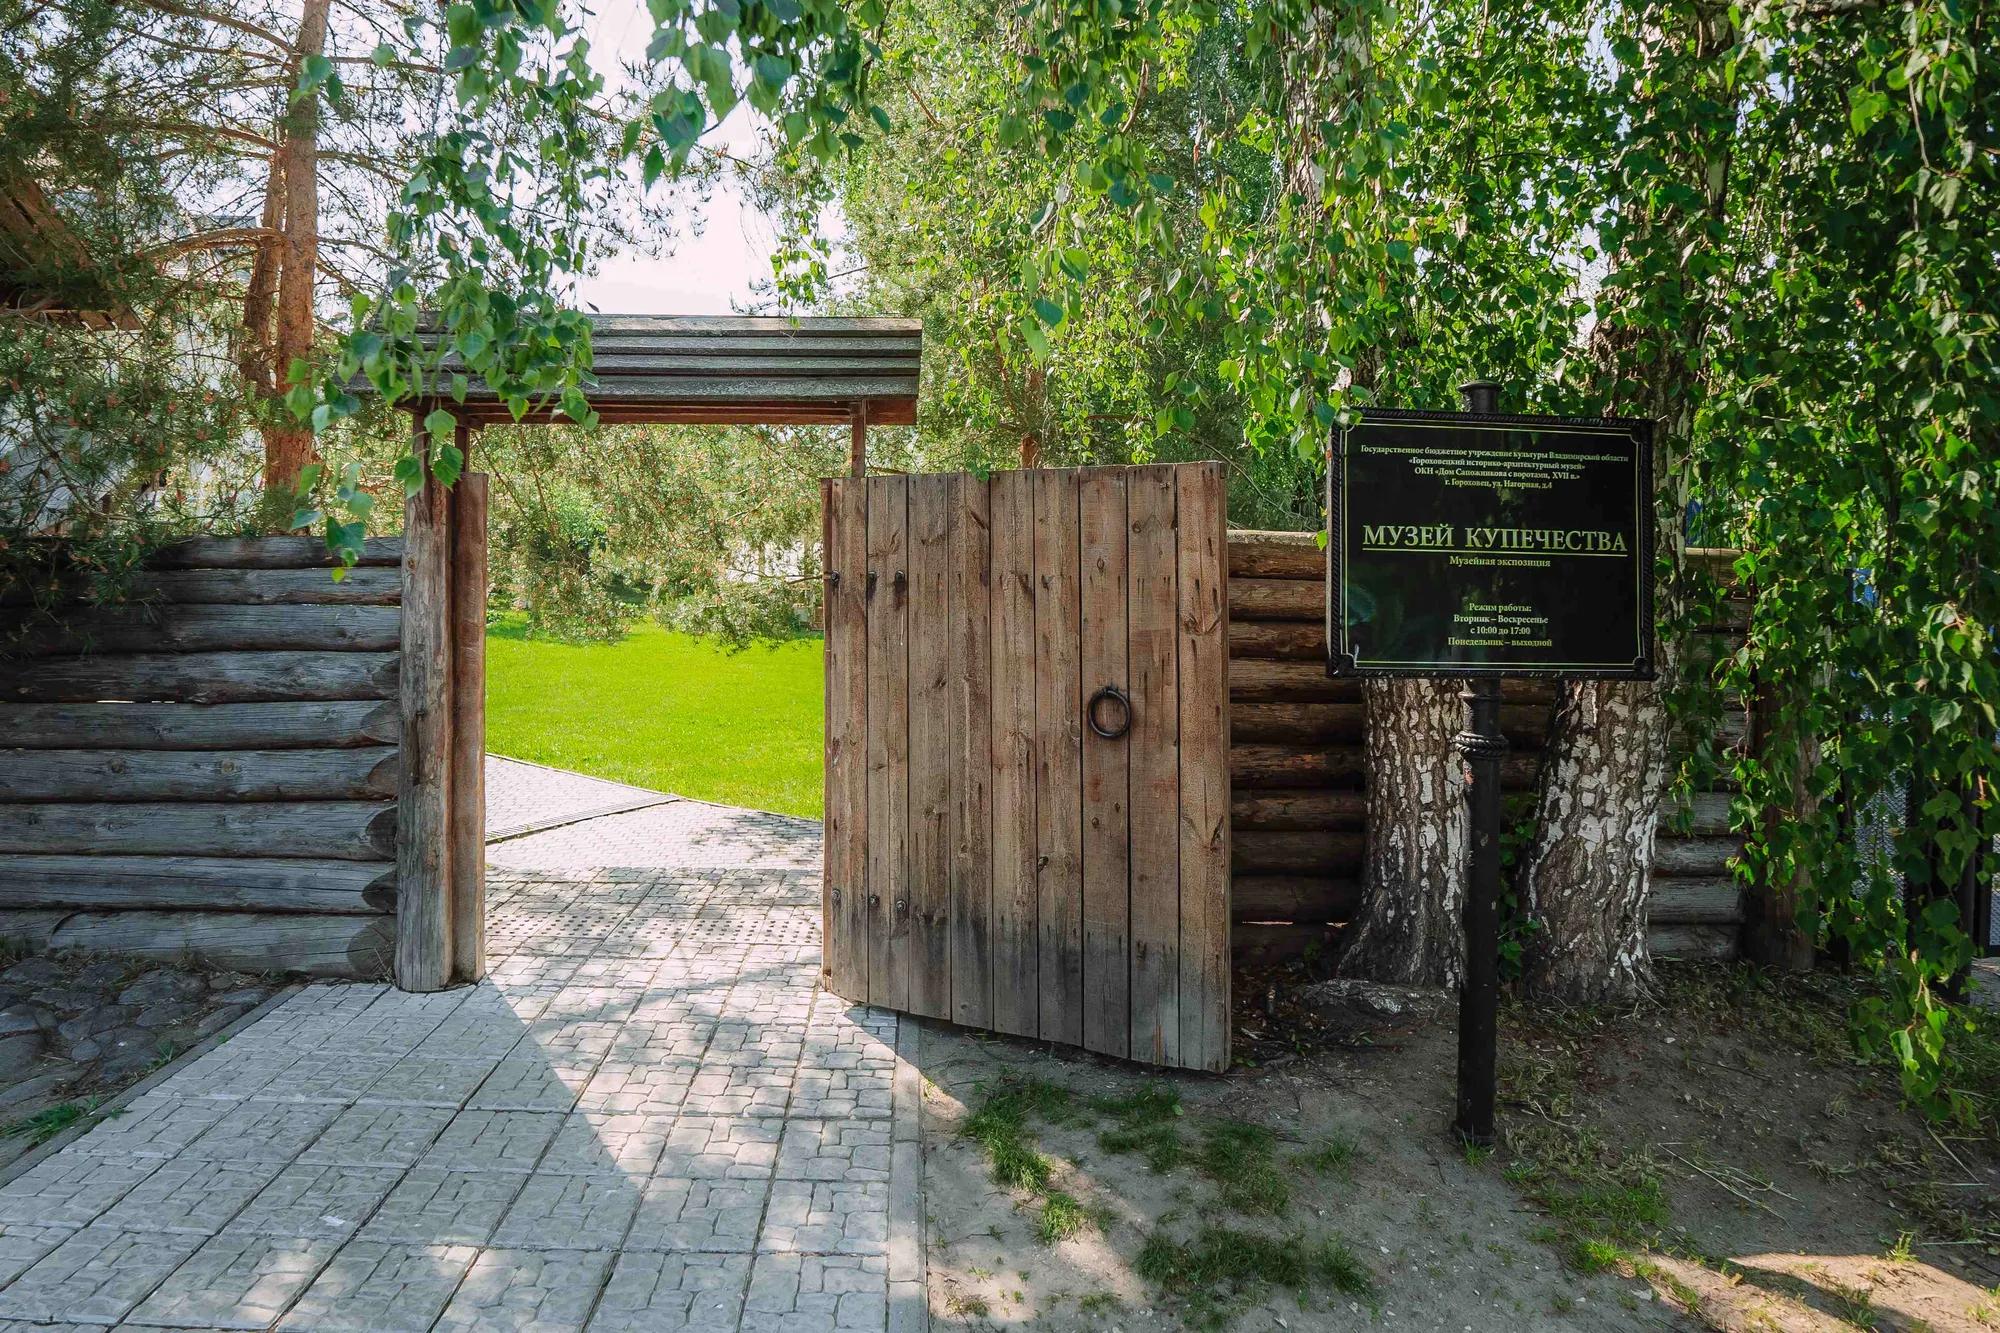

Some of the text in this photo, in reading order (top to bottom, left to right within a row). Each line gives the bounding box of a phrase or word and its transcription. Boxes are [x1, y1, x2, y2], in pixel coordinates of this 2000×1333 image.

[1361, 445, 1423, 455] Государственное
[1425, 447, 1467, 456] бюджетное
[1513, 451, 1547, 459] культуры
[1363, 524, 1627, 551] МУЗЕЙ КУПЕЧЕСТВА
[1449, 556, 1551, 568] Музейная экспозиция
[1469, 603, 1531, 613] Режим работы:
[1454, 614, 1490, 624] Вторник
[1498, 615, 1548, 625] Воскресенье
[1477, 626, 1497, 634] 10:00
[1448, 637, 1504, 646] Понедельник
[1512, 639, 1552, 647] выходной
